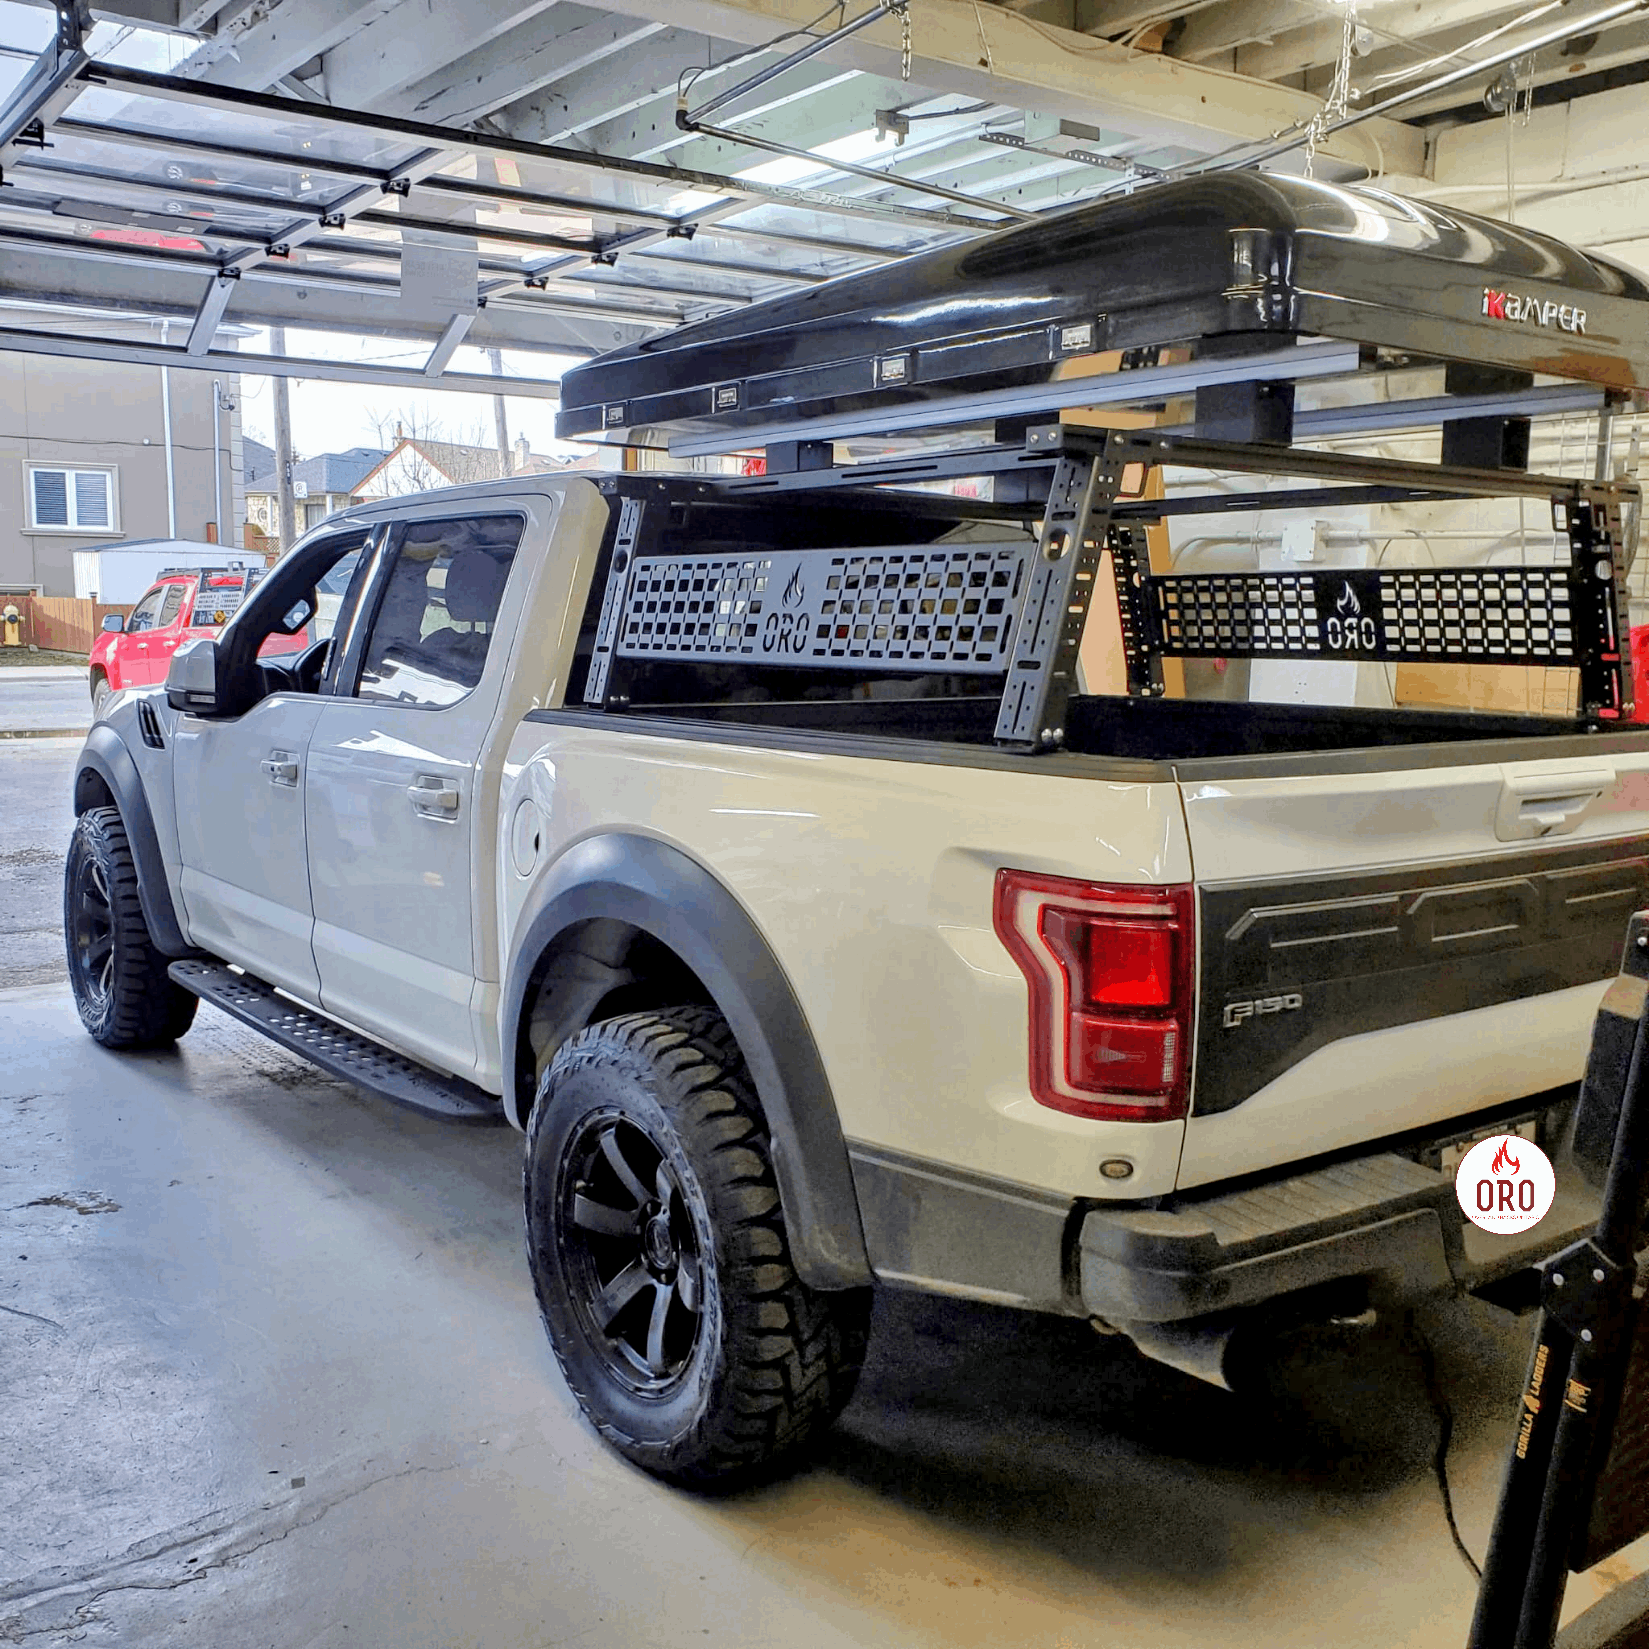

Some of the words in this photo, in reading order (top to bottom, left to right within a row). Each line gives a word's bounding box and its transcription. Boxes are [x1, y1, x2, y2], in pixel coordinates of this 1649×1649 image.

[762, 612, 811, 654] ORO
[1516, 1414, 1533, 1459] GORILLA
[1530, 1344, 1549, 1396] LADDERS
